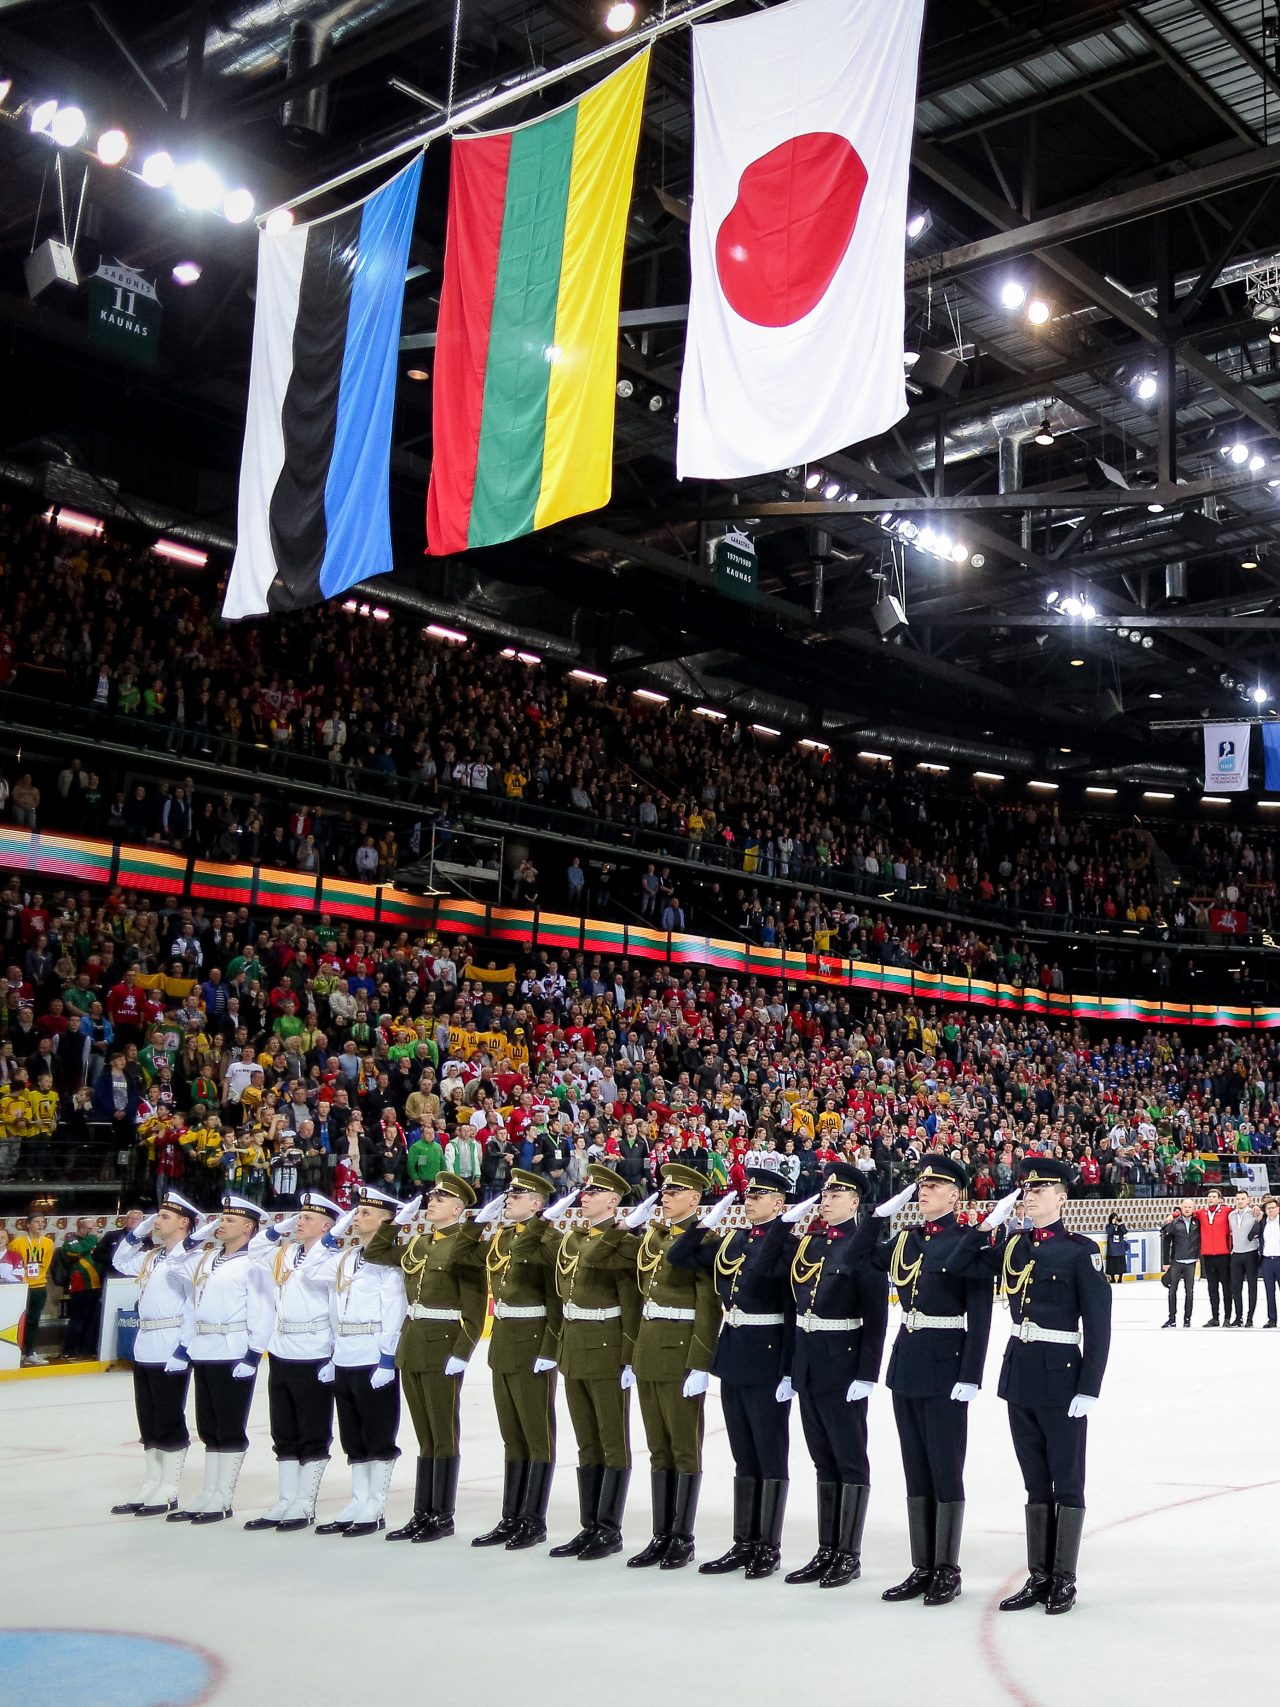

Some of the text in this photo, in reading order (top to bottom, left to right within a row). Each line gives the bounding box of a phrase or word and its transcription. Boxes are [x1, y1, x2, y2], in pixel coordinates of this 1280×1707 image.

[104, 267, 151, 293] SABONIS
[112, 287, 136, 316] 11
[100, 309, 148, 336] KAUNAS
[726, 566, 752, 583] KAUNAS
